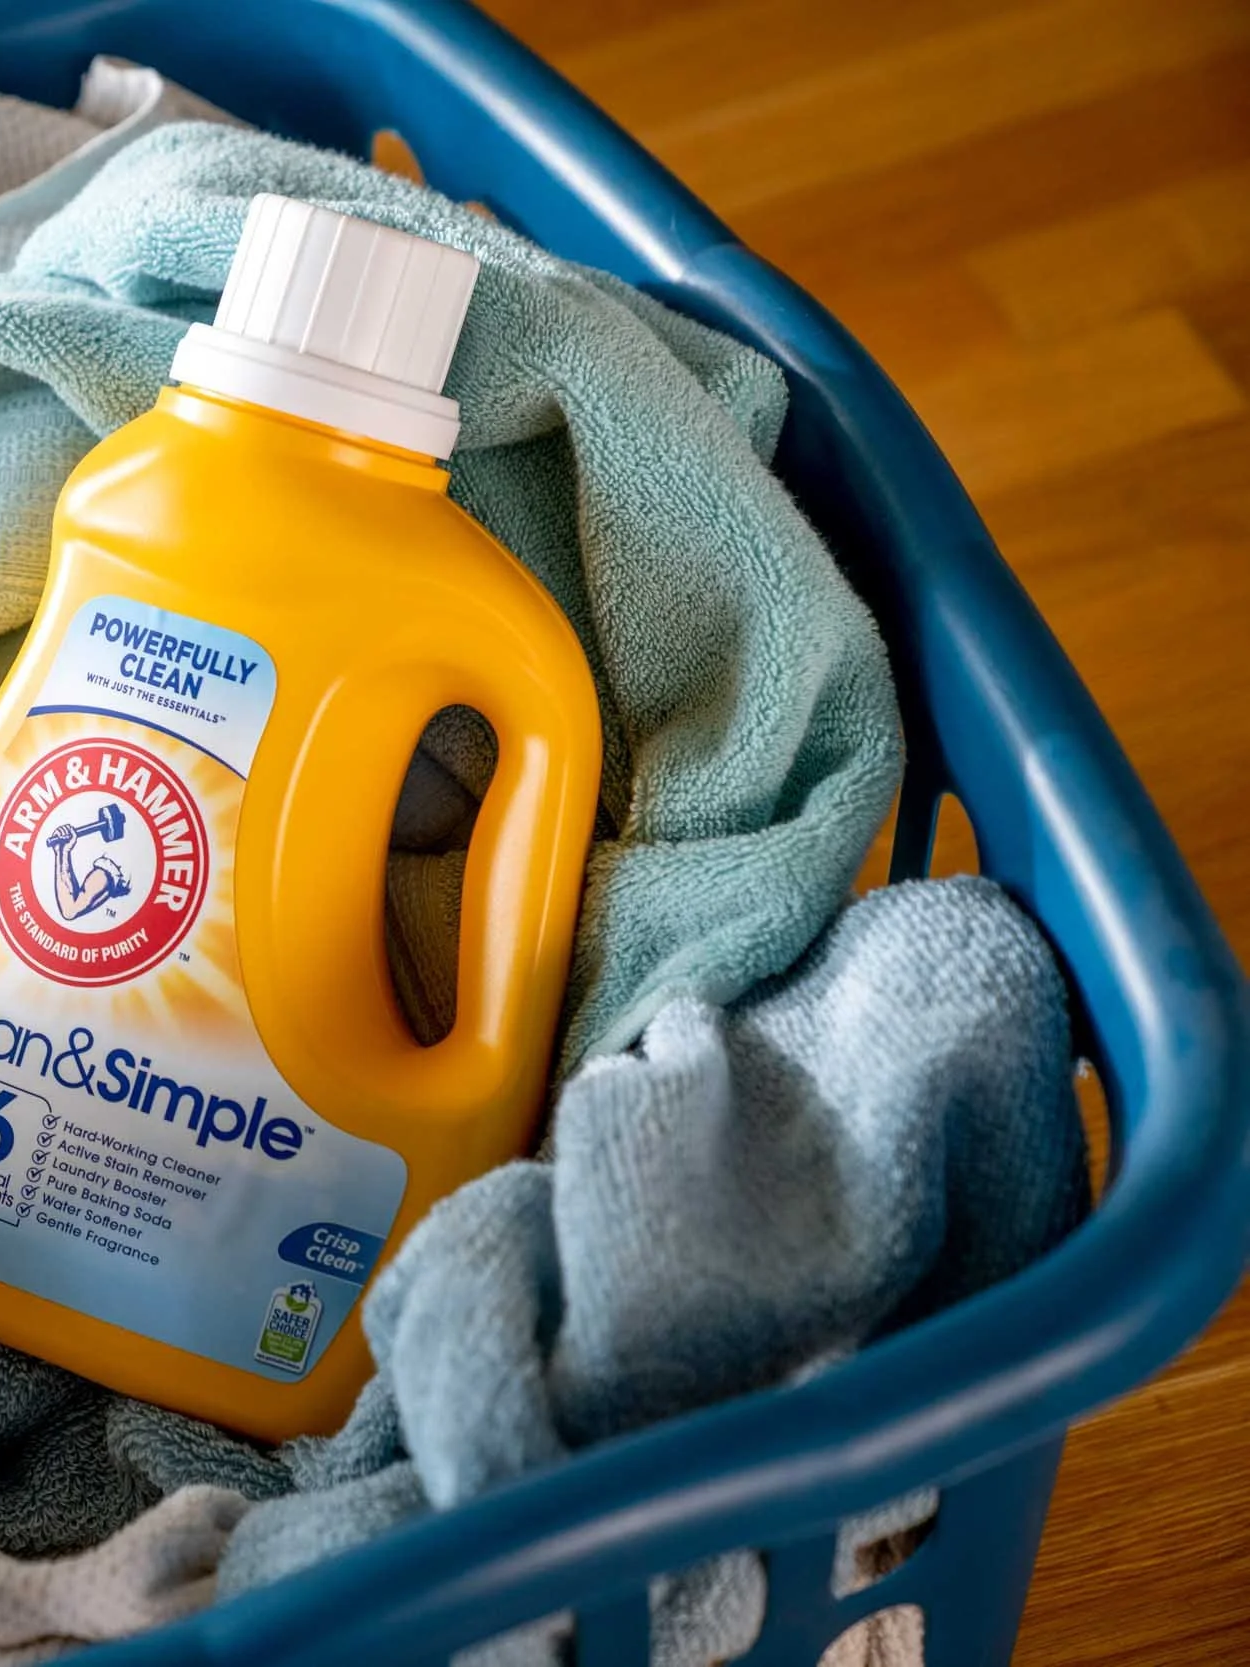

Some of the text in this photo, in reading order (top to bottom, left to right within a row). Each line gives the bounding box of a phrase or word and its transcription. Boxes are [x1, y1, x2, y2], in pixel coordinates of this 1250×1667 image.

[89, 612, 258, 685] POWERFULLY
[86, 671, 110, 688] WITH
[111, 681, 135, 696] JUST
[136, 688, 155, 703] THE
[119, 653, 204, 700] CLEAN
[4, 753, 195, 913] ARM & HAMMER
[8, 882, 150, 963] THE STANDARD OF PURITY
[57, 1139, 208, 1201] Active Stain Remover
[63, 1120, 221, 1186] Hard-Working Cleaner
[46, 1175, 172, 1230] Pure Baking Soda
[52, 1157, 167, 1207] Laundry Booster
[36, 1211, 160, 1266] Gentle Fragrance
[42, 1191, 143, 1240] Water Softener
[313, 1228, 361, 1257] Crisp
[269, 1319, 308, 1340] CHOICE
[272, 1308, 311, 1329] SAFER
